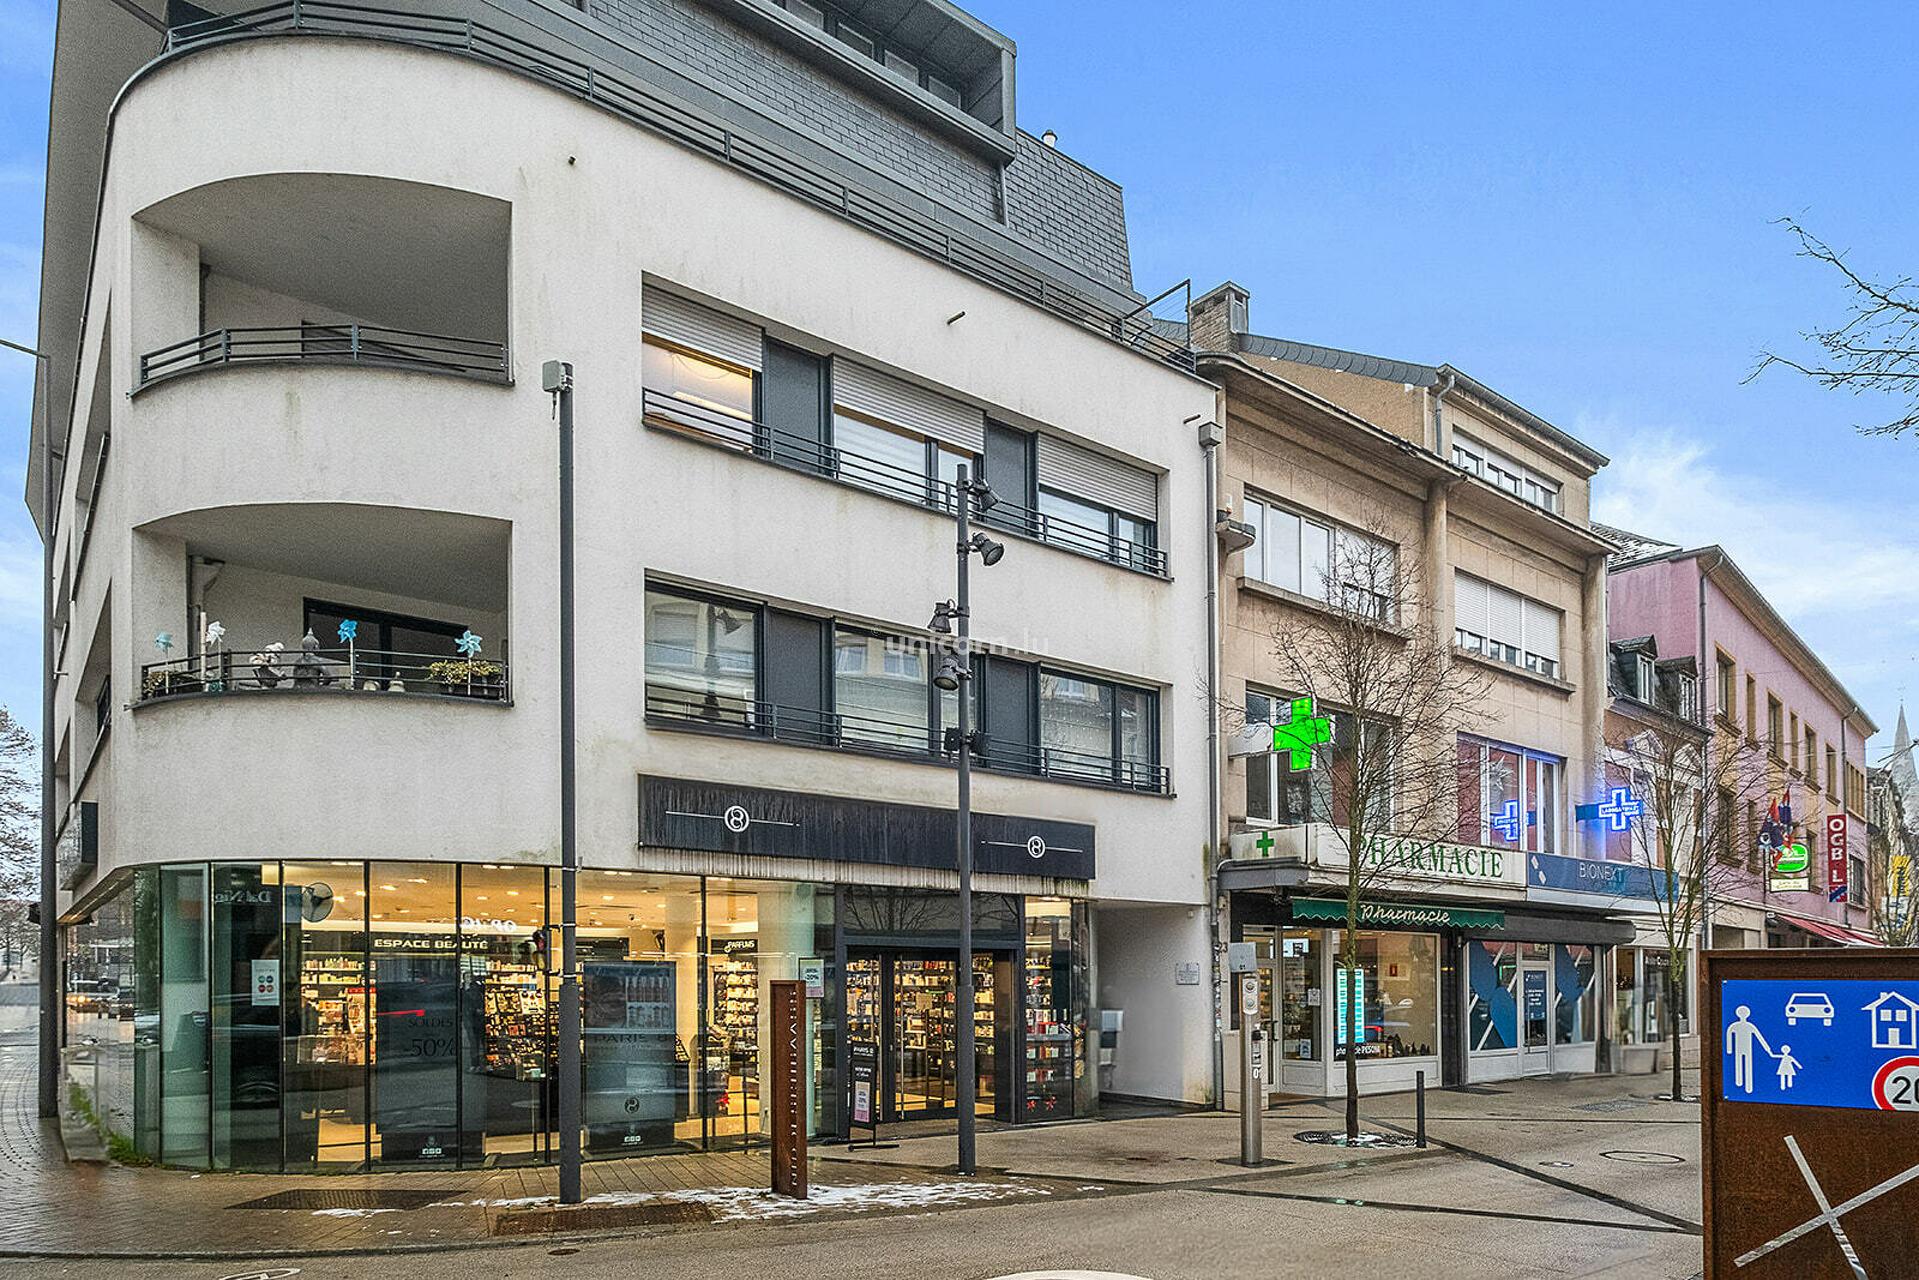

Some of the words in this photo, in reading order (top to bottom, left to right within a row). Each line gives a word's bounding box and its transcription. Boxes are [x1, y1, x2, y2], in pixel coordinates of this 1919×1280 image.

[1579, 862, 1624, 882] BIONEXT
[1360, 904, 1451, 922] Pharmacie
[373, 938, 430, 949] ESPACE
[1892, 1075, 1919, 1105] 2
